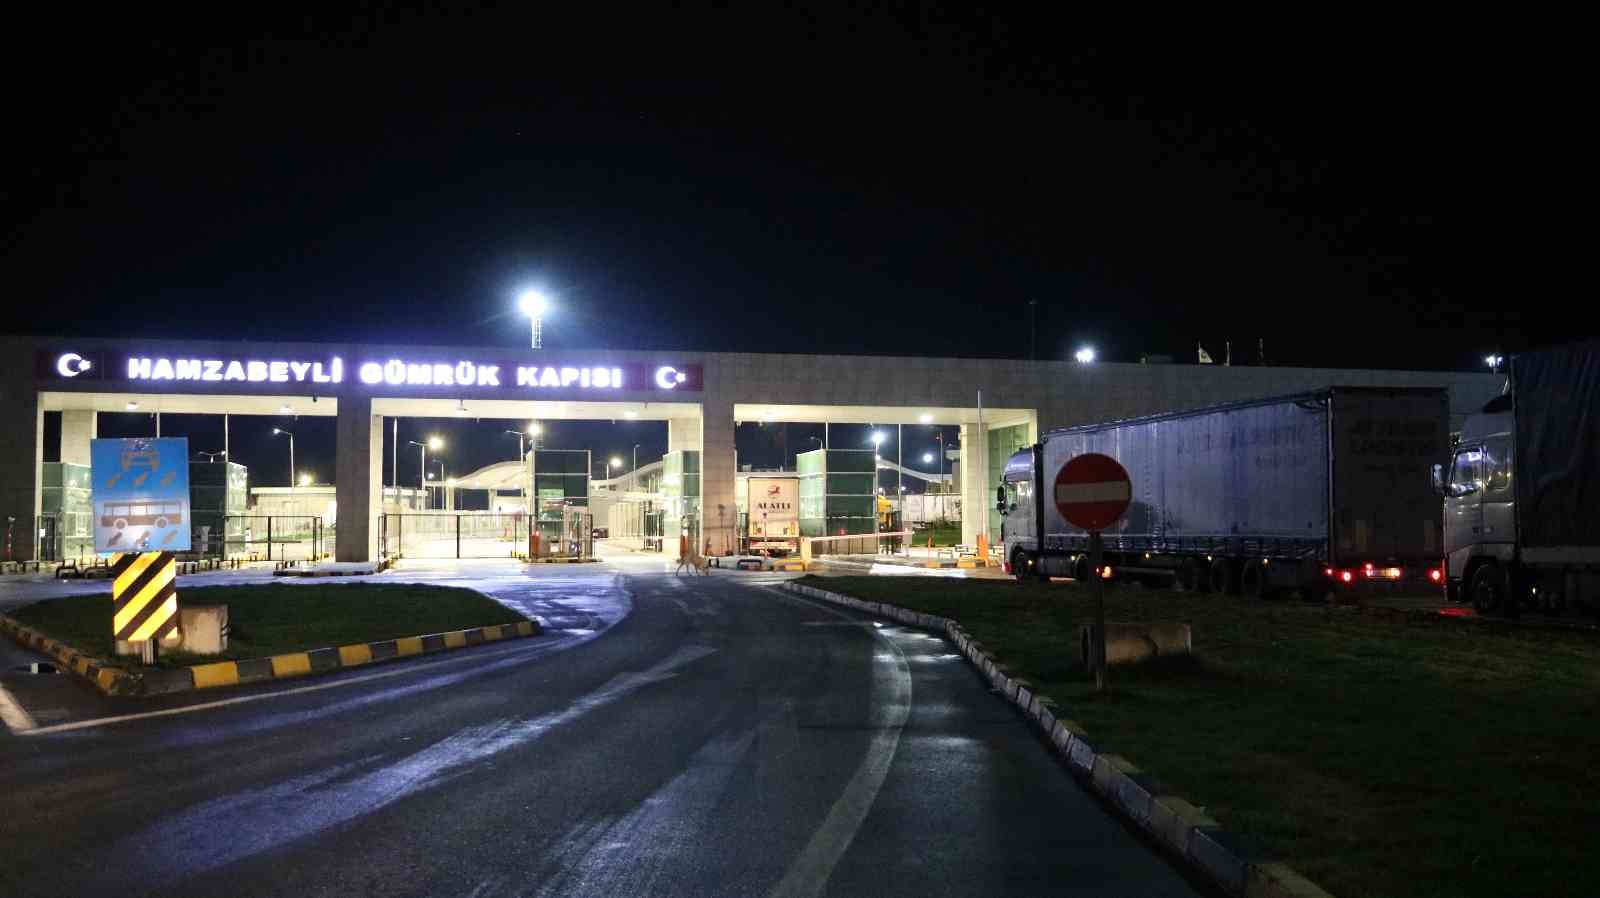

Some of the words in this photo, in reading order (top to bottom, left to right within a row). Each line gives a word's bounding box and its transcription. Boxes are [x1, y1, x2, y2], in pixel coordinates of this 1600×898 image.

[128, 357, 343, 383] HAMZABEYLİ
[360, 360, 500, 386] GÜMRÜK
[517, 366, 622, 388] KAPISI
